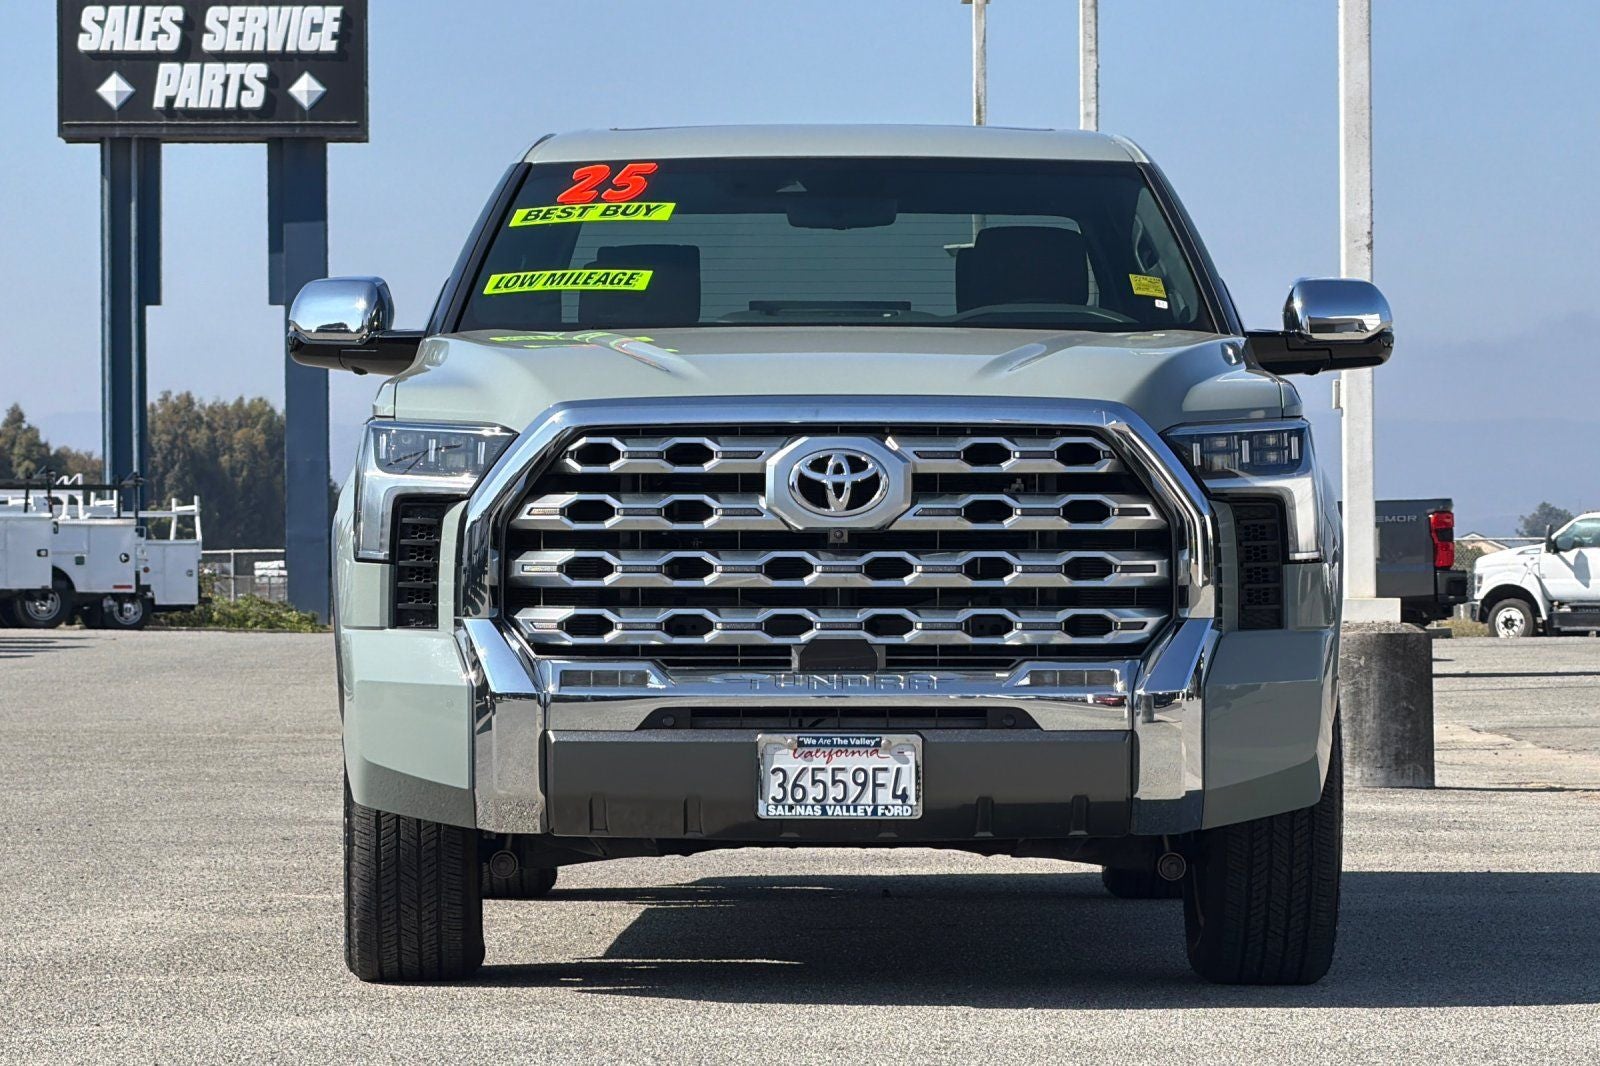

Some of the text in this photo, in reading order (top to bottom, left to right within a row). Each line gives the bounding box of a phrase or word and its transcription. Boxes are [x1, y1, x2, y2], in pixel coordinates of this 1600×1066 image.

[77, 5, 344, 52] SALES SERVICE
[152, 62, 269, 110] PARTS
[556, 162, 658, 204] 25
[520, 204, 665, 223] BEST BUY
[492, 271, 643, 290] LOW MILEAGE
[818, 737, 832, 745] Are
[832, 737, 849, 745] The
[792, 747, 890, 764] California
[770, 767, 909, 803] 36559F4
[767, 806, 912, 816] SALINAS VALLEY FORD
